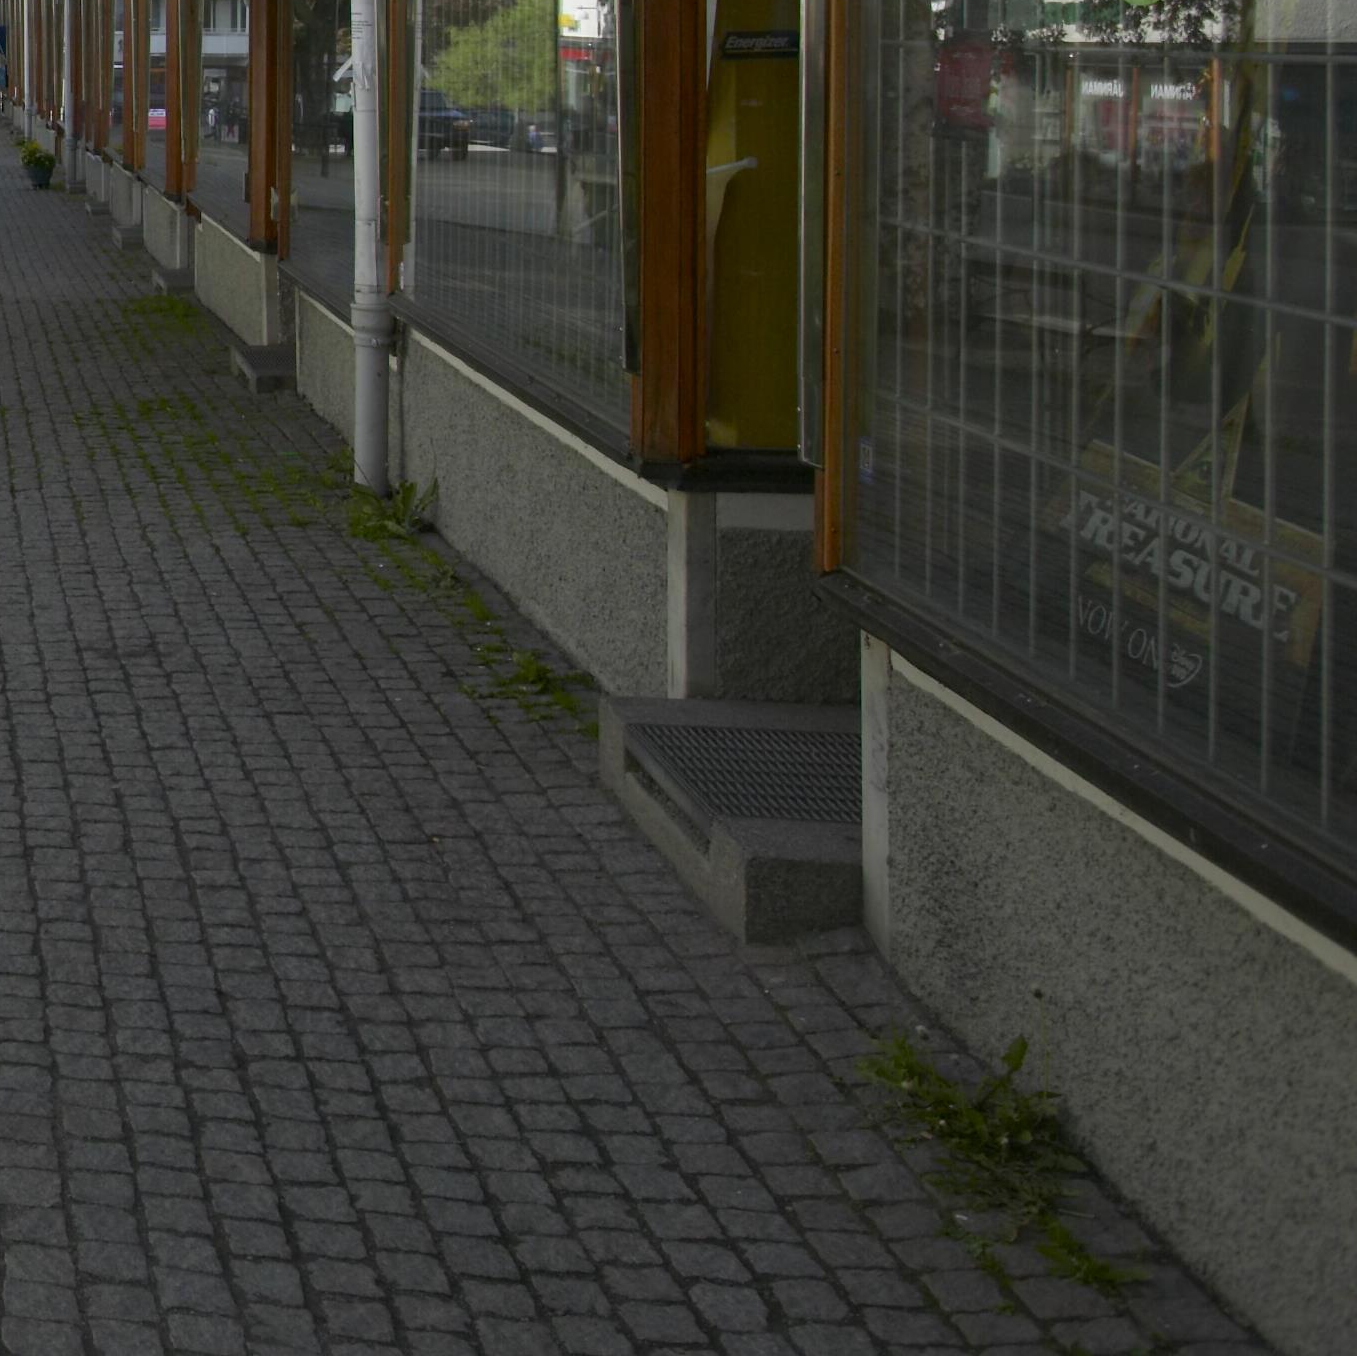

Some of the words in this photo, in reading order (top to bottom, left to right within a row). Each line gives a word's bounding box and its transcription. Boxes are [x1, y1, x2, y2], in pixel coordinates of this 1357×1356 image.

[724, 35, 790, 51] Energizer
[1060, 490, 1301, 643] TREASURE
[1109, 487, 1261, 576] ATIONAL
